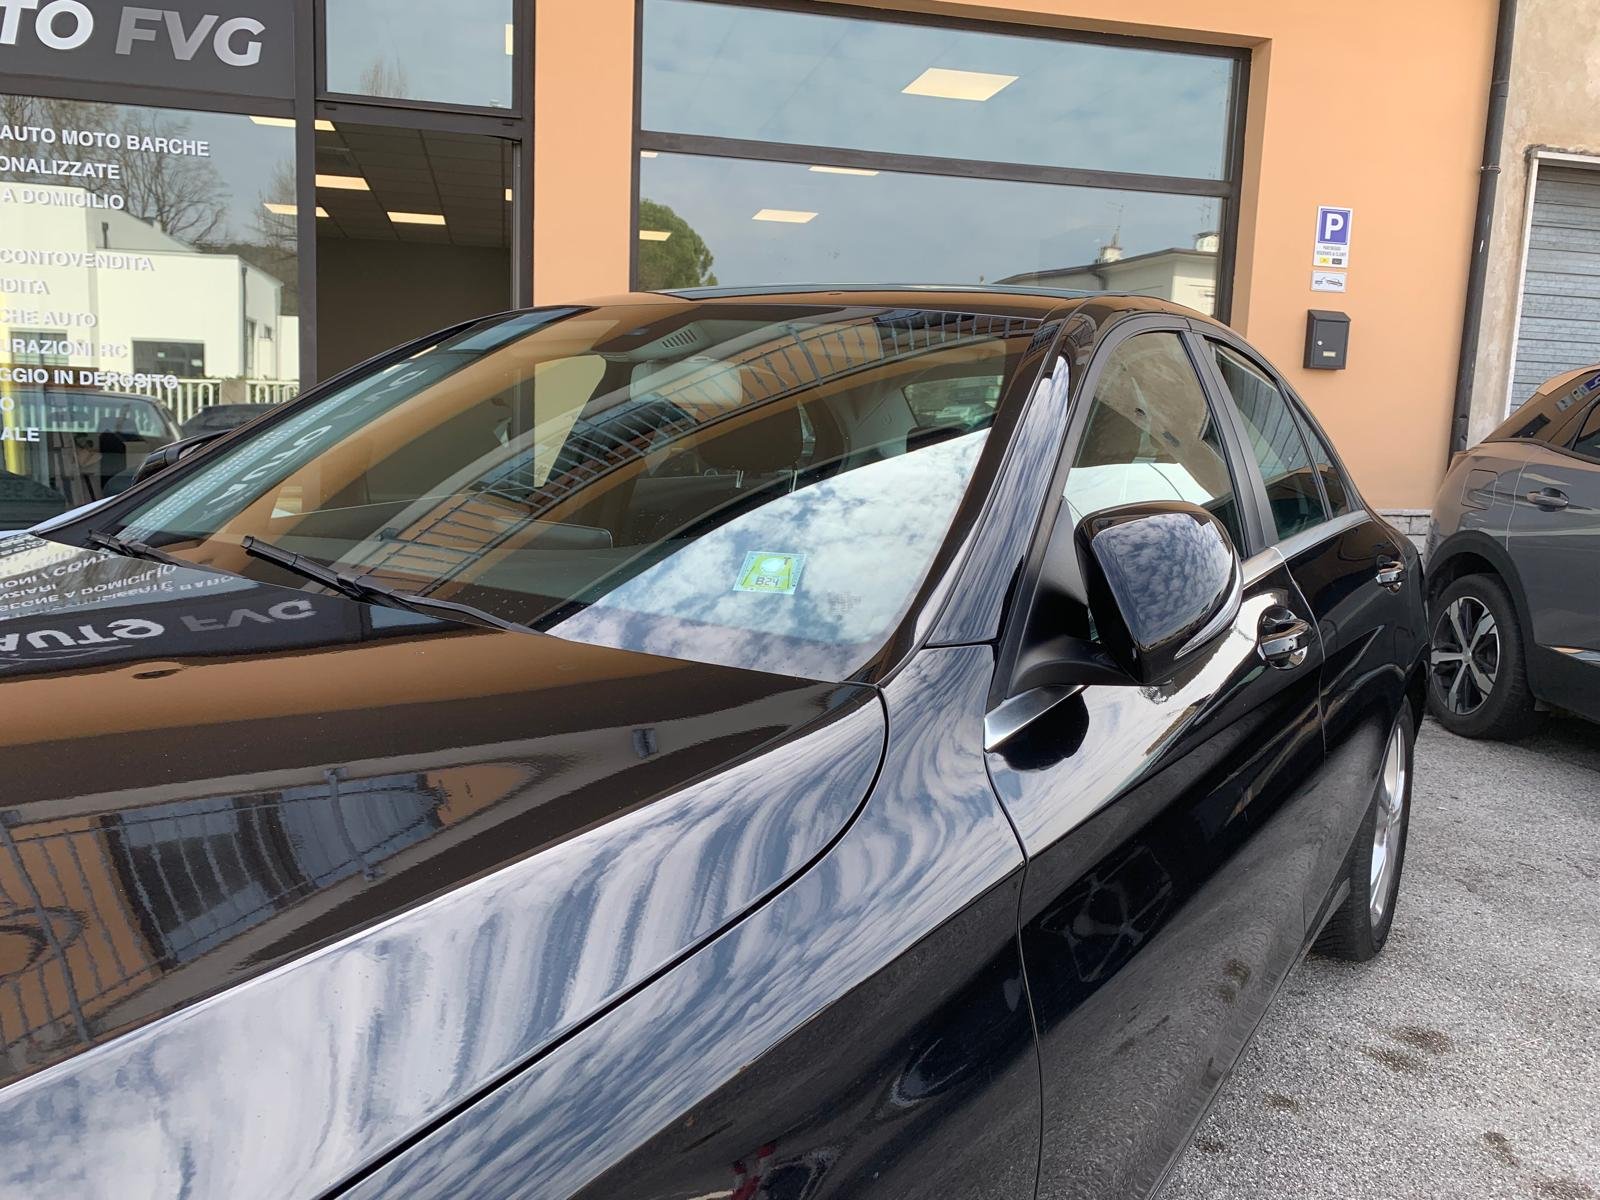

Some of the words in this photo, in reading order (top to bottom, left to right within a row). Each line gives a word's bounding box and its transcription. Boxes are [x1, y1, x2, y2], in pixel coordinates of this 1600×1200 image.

[0, 0, 94, 50] TO
[115, 6, 266, 67] FVG
[0, 125, 56, 144] AUTO
[62, 130, 121, 149] MOTO
[127, 135, 209, 157] BARCHE
[0, 156, 120, 180] ONALIZZATE
[2, 188, 18, 204] A
[22, 189, 125, 210] DOMICILIO
[1324, 212, 1344, 240] P
[0, 248, 155, 272] CONTOVENDITA
[0, 278, 50, 295] DITA
[44, 311, 97, 327] AUTO
[54, 370, 73, 386] IN
[79, 371, 178, 390] DEPOSITO
[1, 427, 40, 442] ALE
